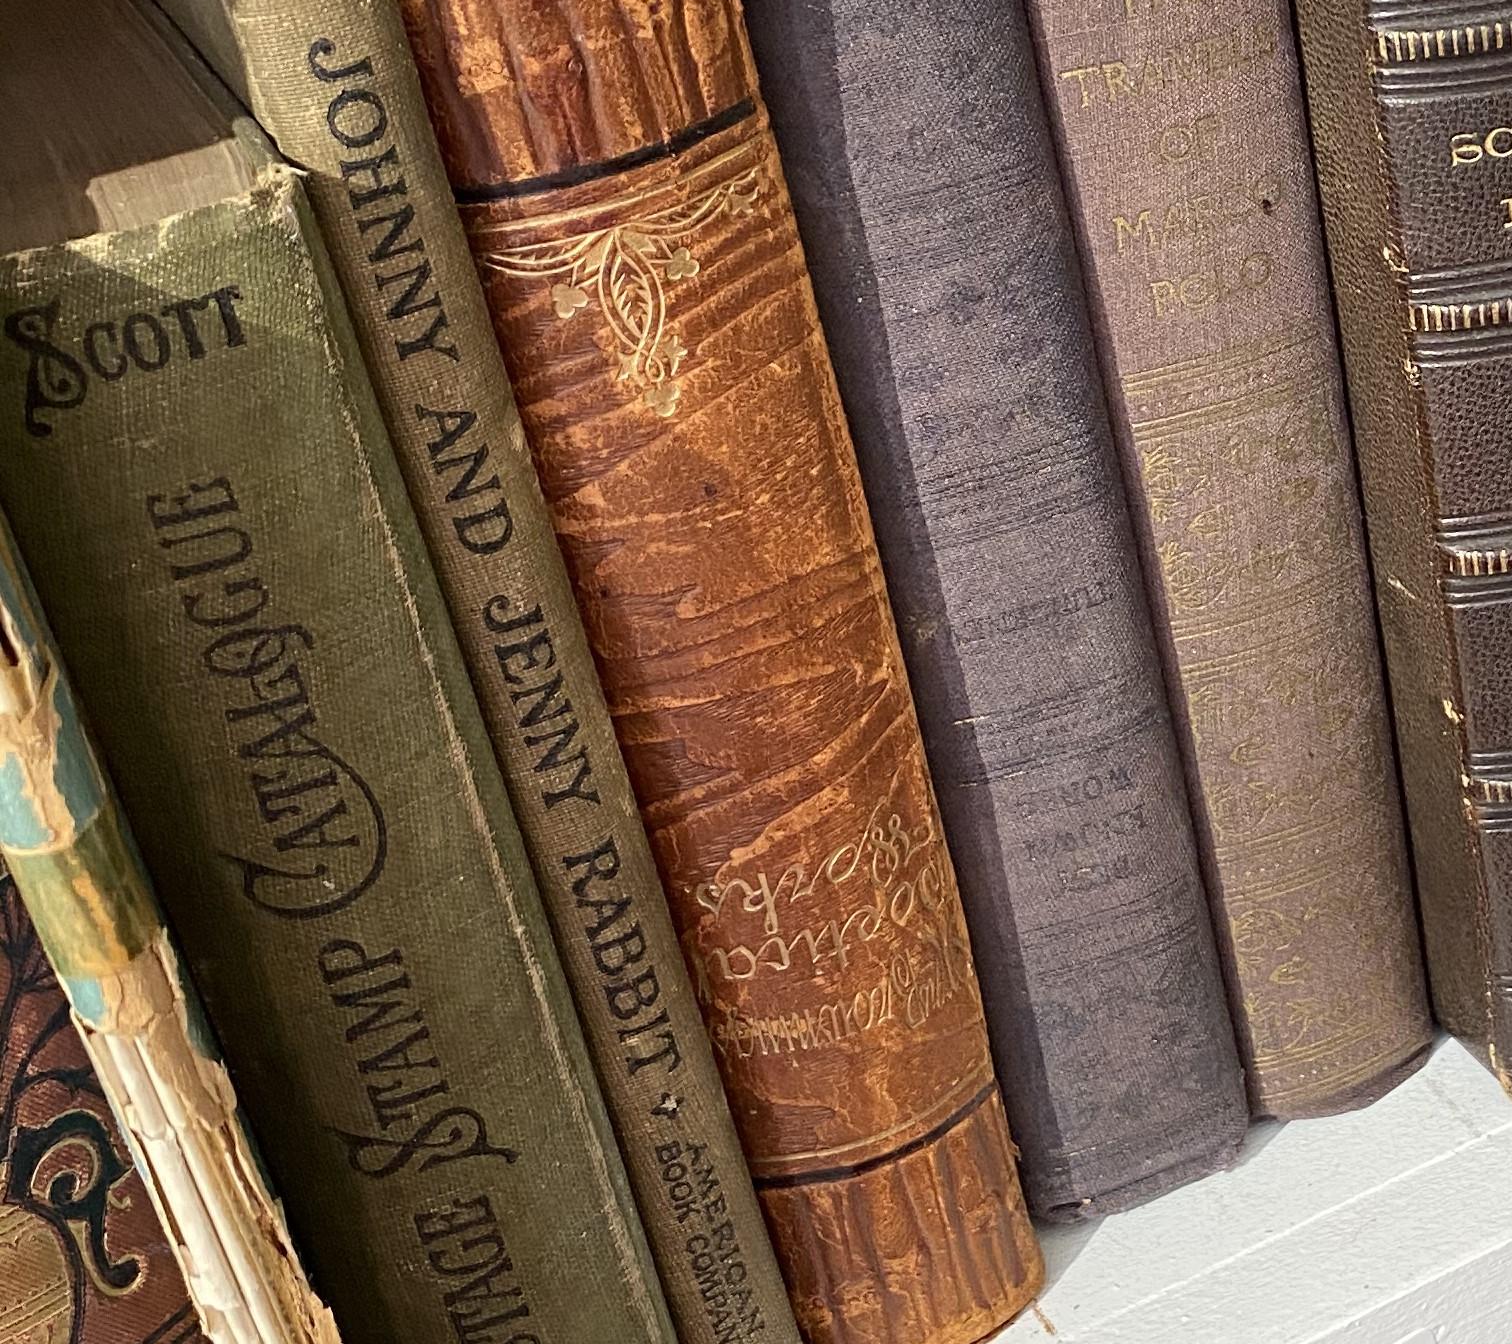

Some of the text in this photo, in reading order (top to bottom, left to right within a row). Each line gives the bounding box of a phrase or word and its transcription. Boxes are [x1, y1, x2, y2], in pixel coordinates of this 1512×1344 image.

[1061, 22, 1278, 109] TRAVELS
[1159, 114, 1221, 165] OF
[1111, 172, 1284, 256] MARCO
[1150, 251, 1271, 319] POLO
[3, 284, 248, 439] SCOTT
[308, 37, 682, 1077] JOHNNY AND JENNY RABBIT
[146, 473, 389, 921] CATALOGUE
[316, 934, 519, 1182] STAMP
[655, 1140, 701, 1224] BOOK
[685, 1142, 767, 1339] AMERICAN
